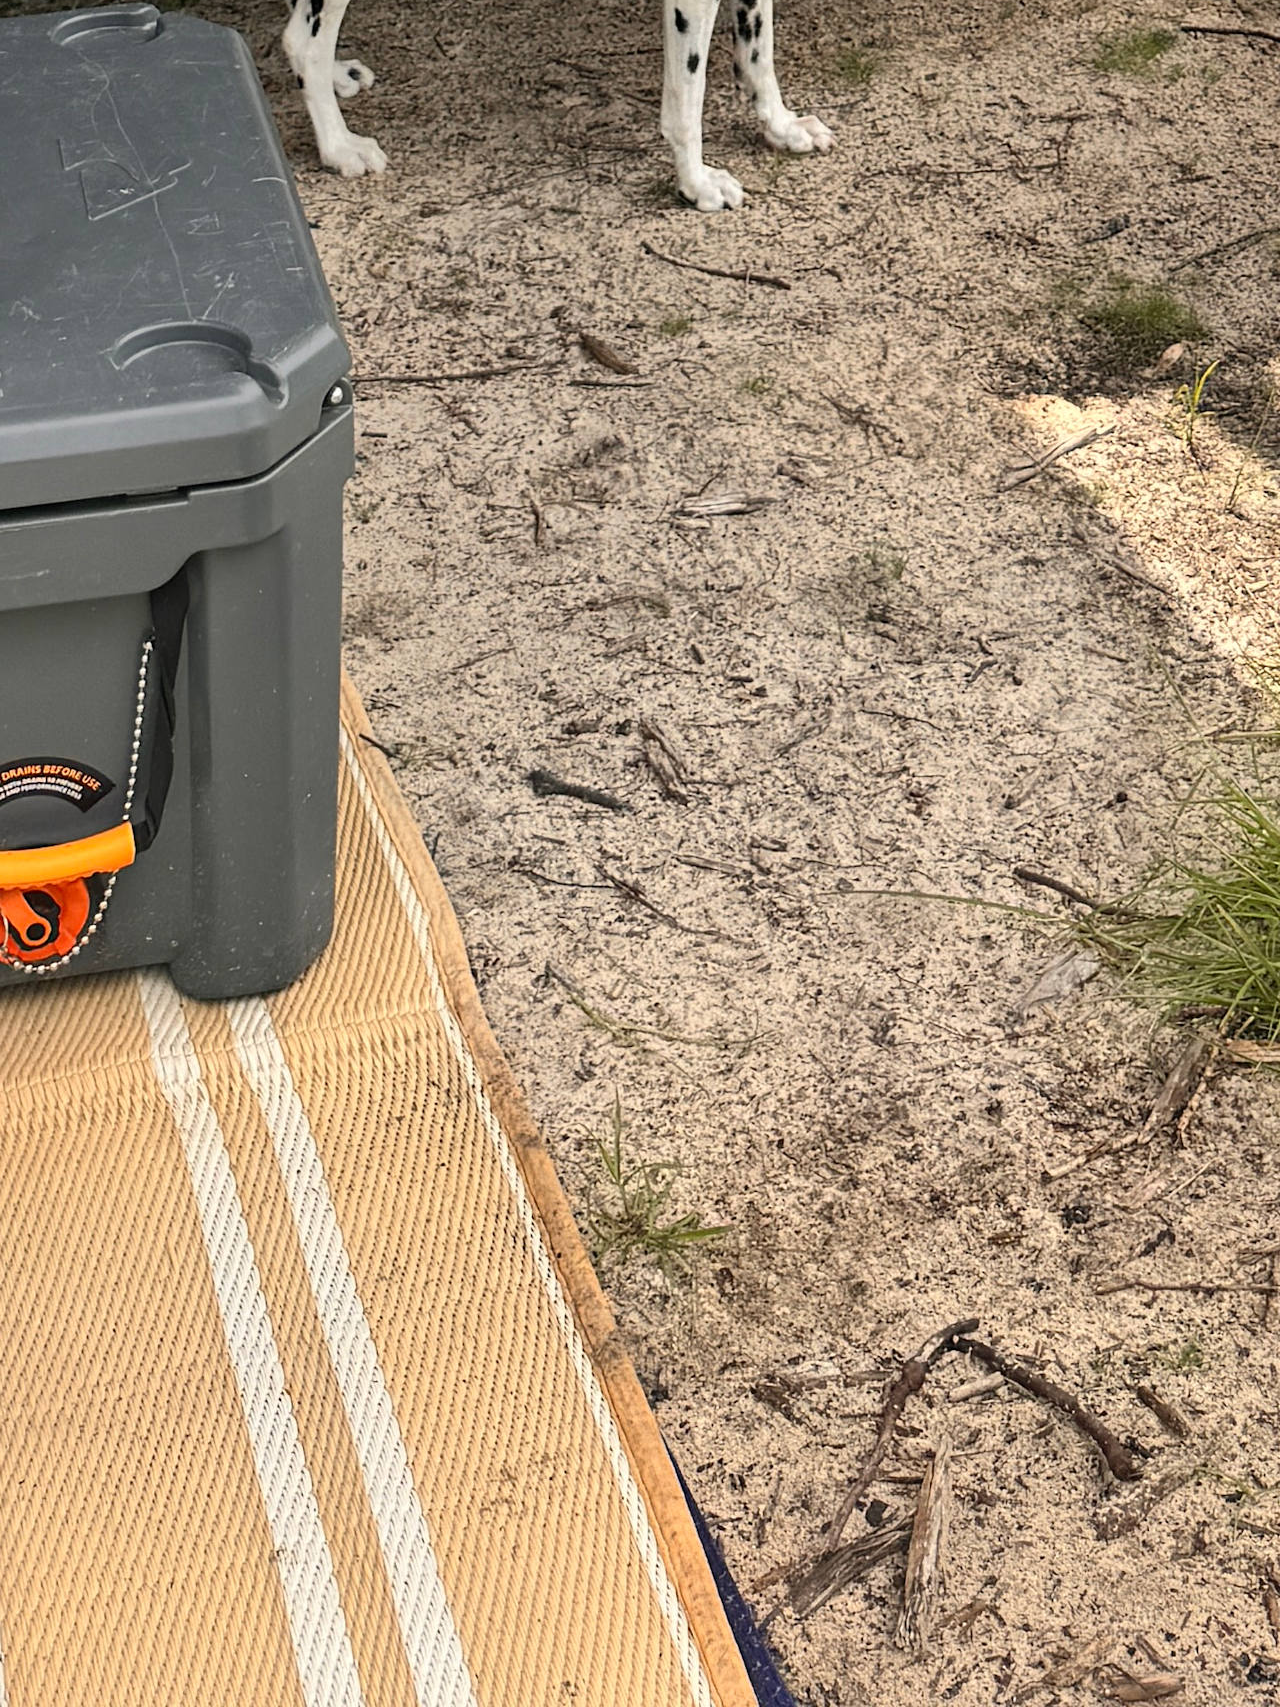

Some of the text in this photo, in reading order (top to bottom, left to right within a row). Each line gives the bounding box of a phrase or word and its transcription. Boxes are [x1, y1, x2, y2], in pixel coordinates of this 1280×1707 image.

[1, 765, 42, 781] DRAINS
[42, 764, 83, 780] BEFORE
[81, 774, 101, 791] USE
